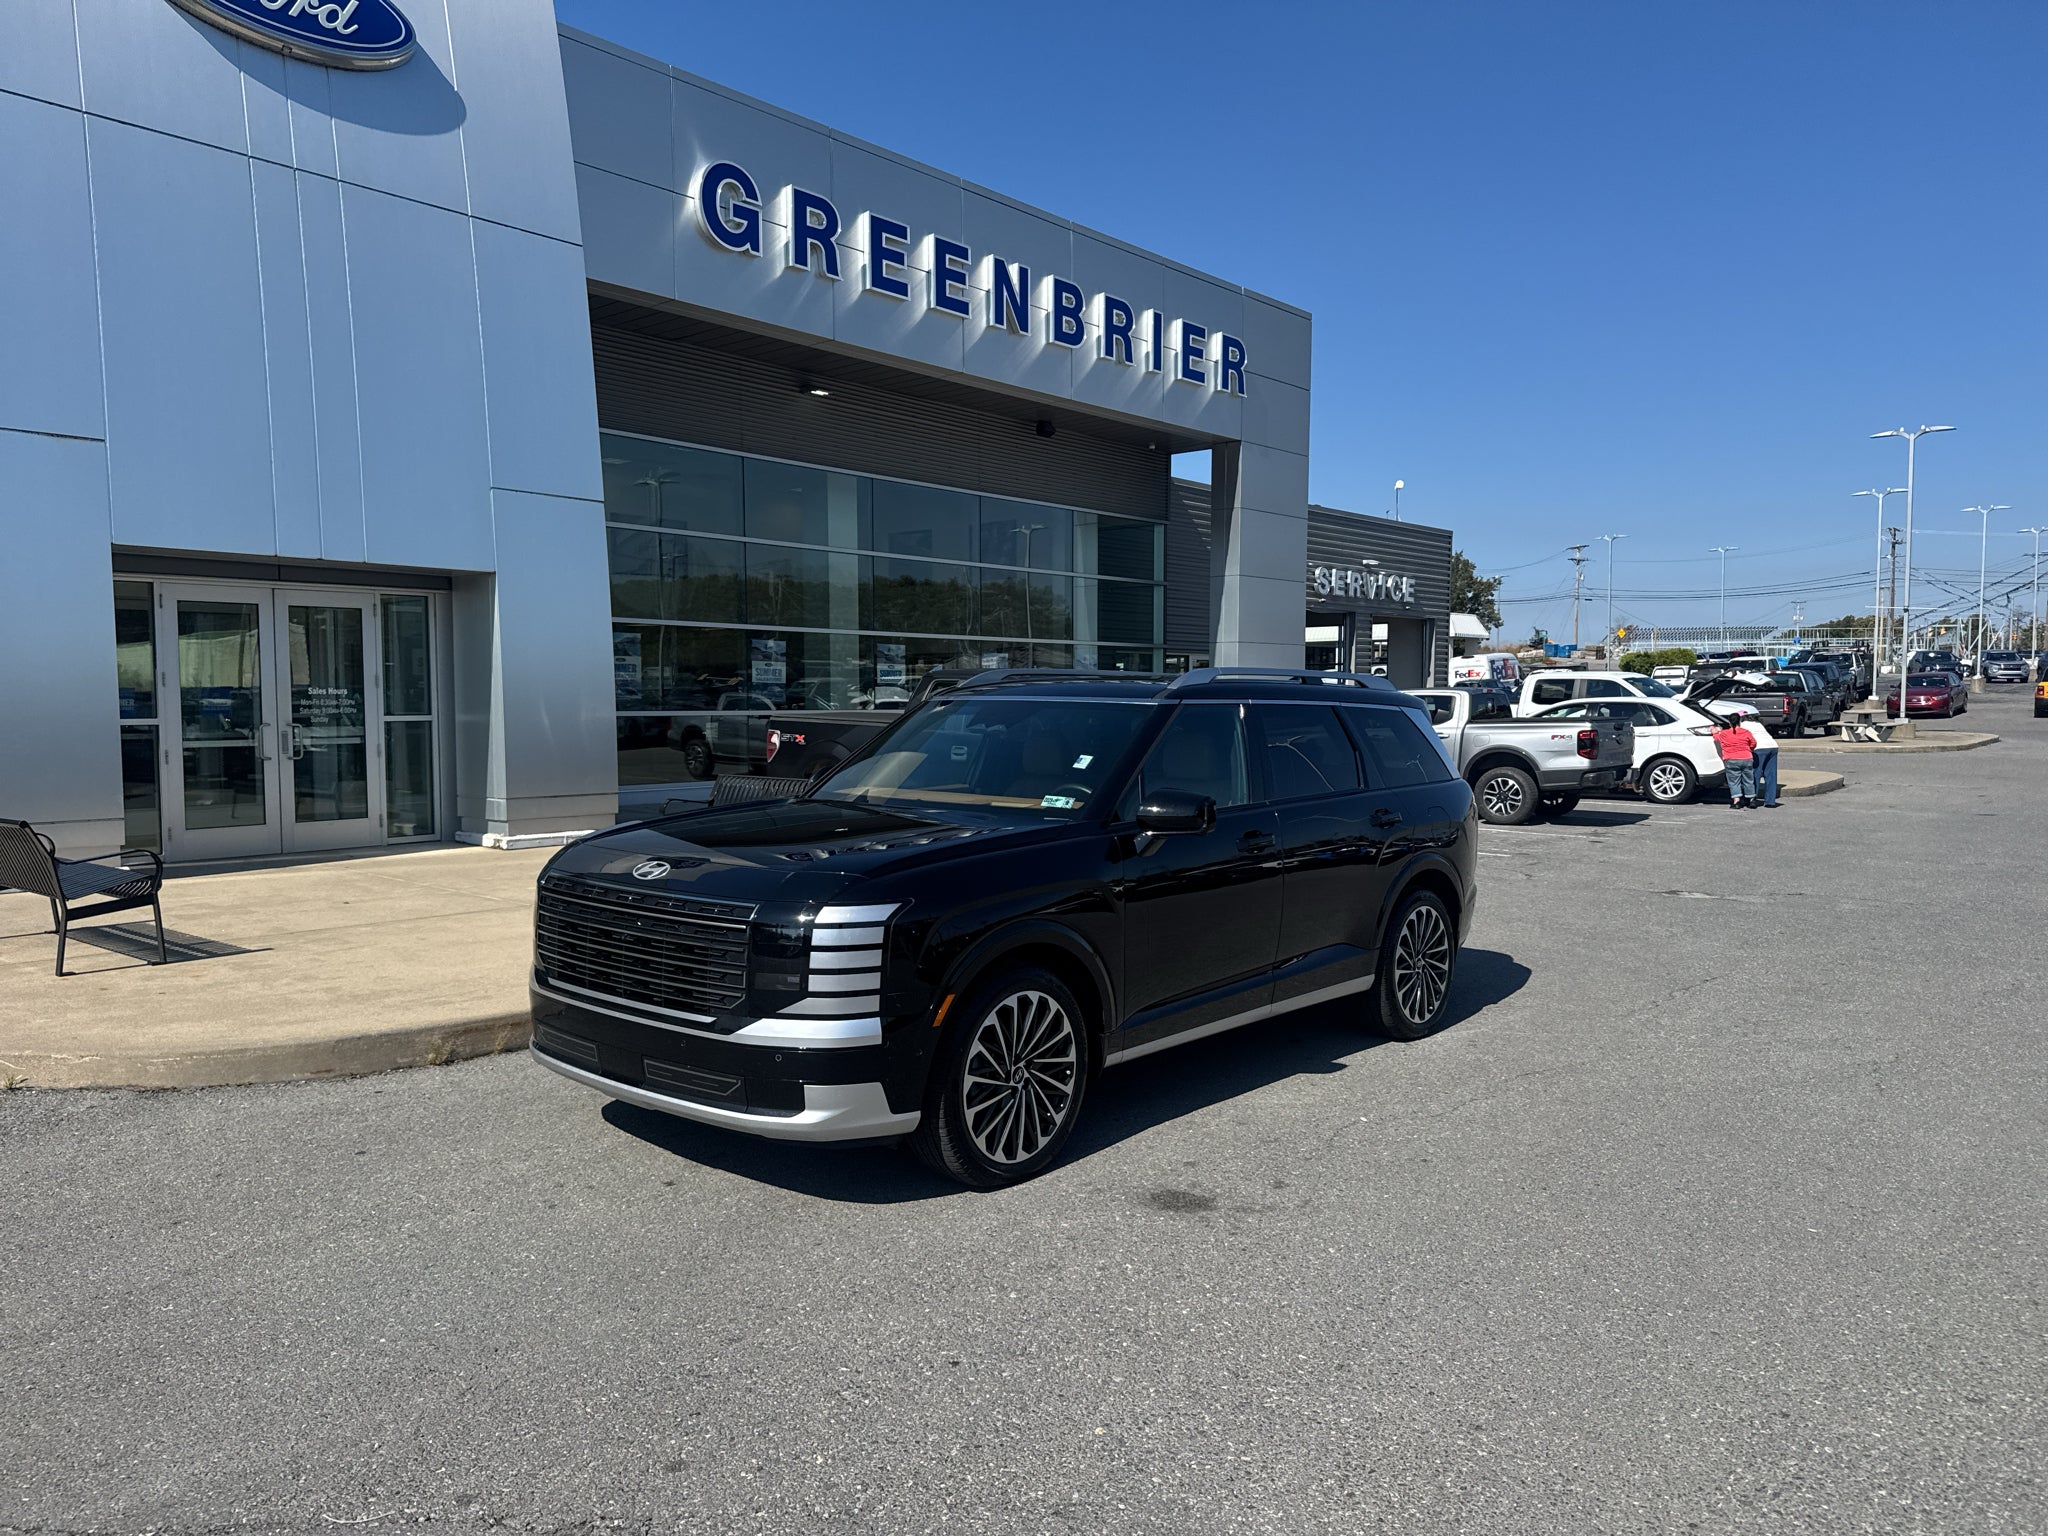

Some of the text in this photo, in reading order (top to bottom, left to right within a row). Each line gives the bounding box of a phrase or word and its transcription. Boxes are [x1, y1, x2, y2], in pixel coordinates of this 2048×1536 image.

[696, 160, 1248, 398] GREENBRIER
[1314, 566, 1416, 603] SERVICE
[1454, 669, 1481, 679] FedEx
[1490, 658, 1517, 680] FedEx
[307, 687, 348, 695] Sales Hours
[299, 707, 321, 716] Saturday
[310, 715, 329, 725] Sunday
[780, 733, 806, 743] STX
